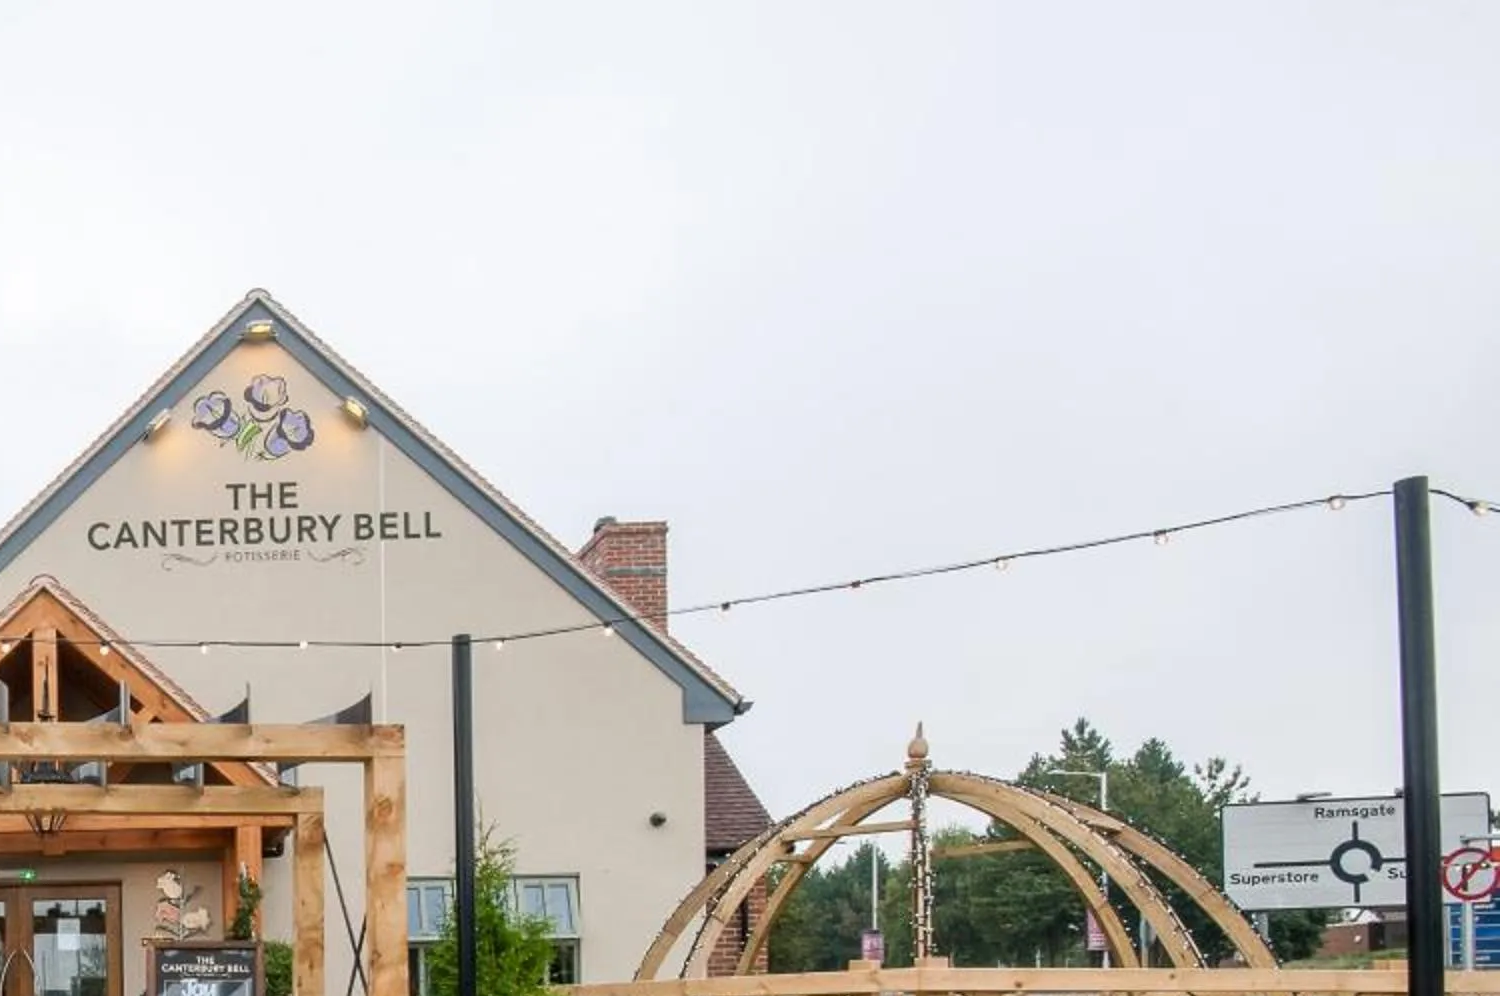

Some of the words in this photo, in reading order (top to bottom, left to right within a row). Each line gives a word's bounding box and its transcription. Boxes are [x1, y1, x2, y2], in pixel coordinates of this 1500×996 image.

[225, 482, 299, 511] THE
[87, 513, 342, 550] CANTERBURY
[353, 511, 442, 541] BELL
[1314, 805, 1396, 819] Ramsgate
[1230, 872, 1319, 885] Superstore
[196, 955, 215, 965] THE
[161, 963, 225, 973] CANTERBURY
[227, 963, 251, 973] BELL
